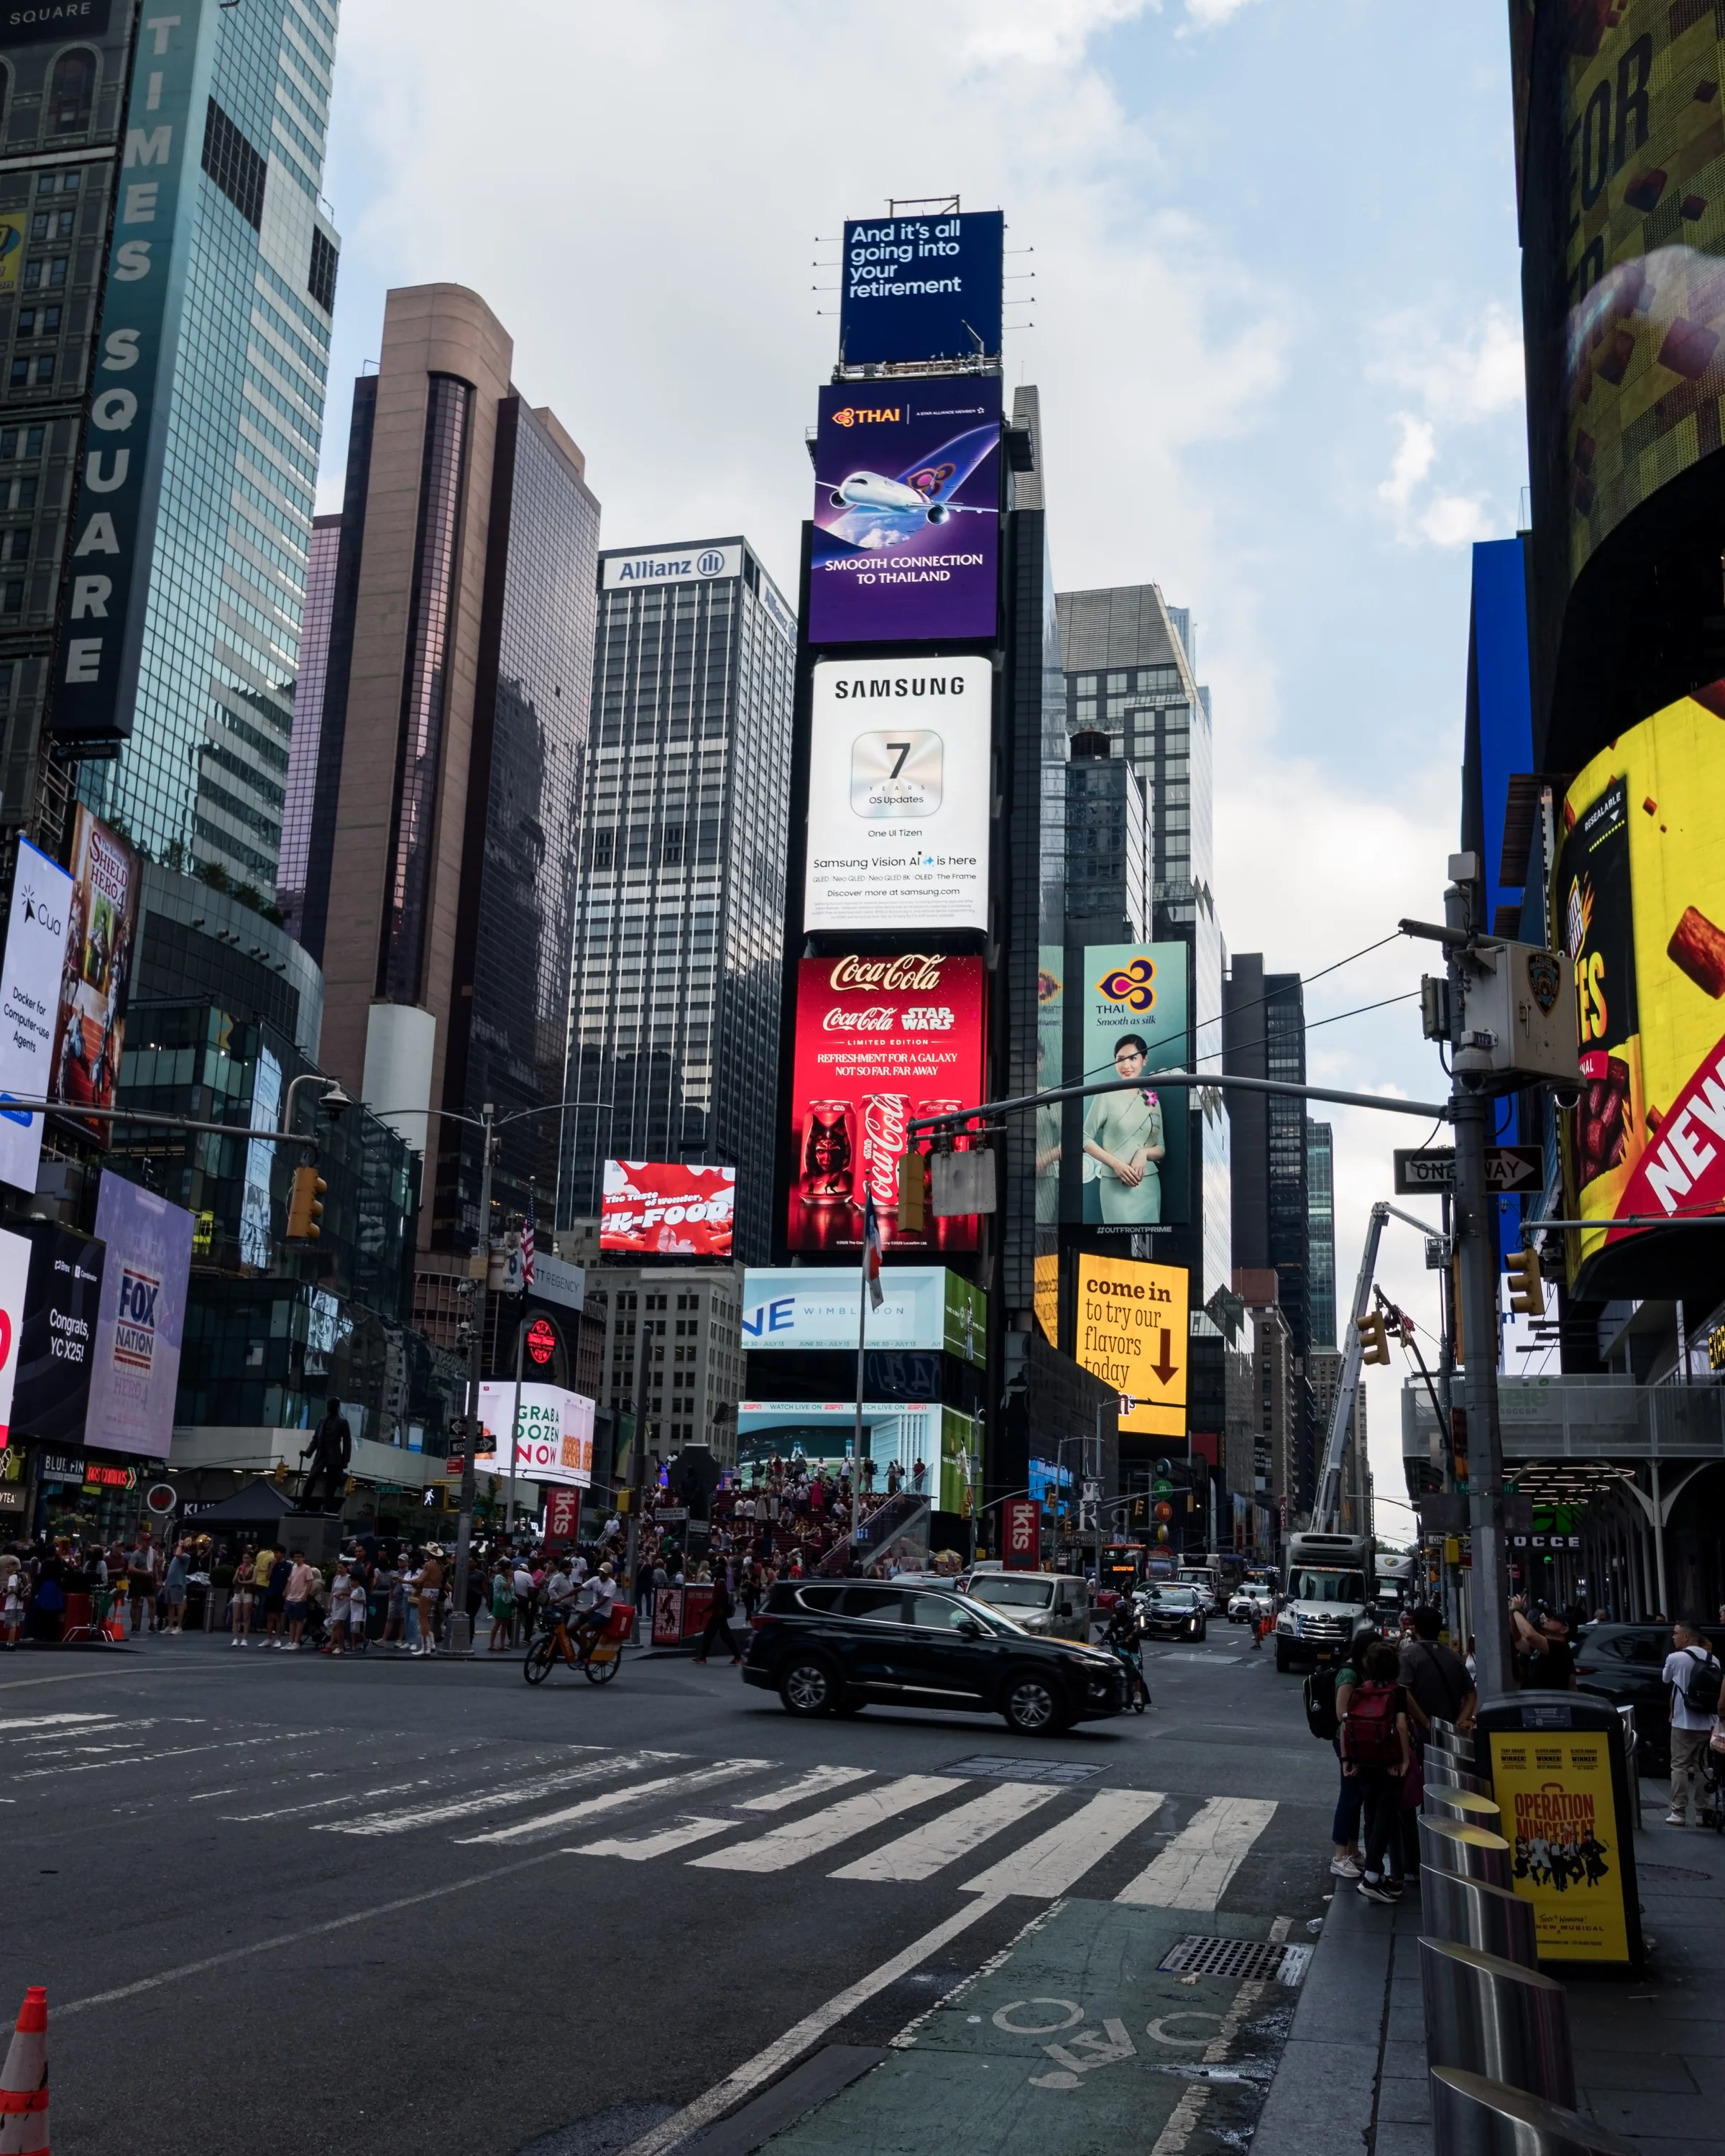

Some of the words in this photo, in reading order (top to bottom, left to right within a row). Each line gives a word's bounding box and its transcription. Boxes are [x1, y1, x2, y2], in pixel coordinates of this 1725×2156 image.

[9, 2, 91, 25] SQUARE
[114, 14, 182, 282] TIMES
[851, 224, 895, 243] And
[901, 223, 929, 240] it's
[935, 219, 960, 237] all
[851, 243, 913, 265] going
[919, 241, 960, 257] into
[850, 265, 898, 284] your
[850, 277, 962, 298] retirement
[855, 408, 900, 423] THAI
[64, 329, 142, 684] SQUARE
[619, 560, 691, 581] Allianz
[825, 558, 887, 571] SMOOTH
[891, 554, 983, 569] CONNECTION
[857, 573, 875, 584] TO
[878, 570, 950, 584] THAILAND
[834, 676, 965, 699] SAMSUNG
[886, 743, 911, 779] 7
[883, 796, 924, 806] Updates
[1584, 790, 1622, 832] RESEALABLE
[89, 831, 128, 888] SHIELD
[814, 858, 868, 870] Samsung
[871, 857, 906, 867] Vision
[937, 856, 946, 866] is
[949, 856, 977, 865] here
[91, 864, 118, 900] HERO
[117, 890, 125, 915] 4
[900, 889, 960, 897] samsung.com
[38, 903, 61, 935] Cua
[1530, 962, 1559, 975] DEPARTMENT
[1535, 955, 1552, 964] POLICE
[830, 954, 947, 991] Coca-Cola
[13, 986, 36, 1010] Docker
[37, 1000, 47, 1017] for
[1096, 1004, 1124, 1014] THAI
[4, 1004, 50, 1040] Computer-use
[822, 1007, 898, 1031] Coca-Cola
[901, 1007, 954, 1019] STAR
[901, 1019, 954, 1030] WARS
[1096, 1017, 1128, 1027] Smooth
[1142, 1015, 1156, 1025] silk
[13, 1030, 37, 1053] Agents
[1473, 1032, 1491, 1045] NYPD
[817, 1054, 887, 1063] REFRESHMENT
[888, 1053, 908, 1063] FOR
[909, 1053, 917, 1063] A
[918, 1052, 958, 1063] GALAXY
[835, 1067, 855, 1076] NOT
[857, 1067, 871, 1075] SO
[872, 1067, 891, 1077] FAR,
[893, 1067, 911, 1075] FAR
[912, 1066, 938, 1075] AWAY
[862, 1096, 903, 1206] Coca-Cola
[605, 1195, 625, 1204] The
[627, 1191, 658, 1202] Taste
[645, 1198, 657, 1206] of
[608, 1201, 730, 1232] K-FOOD
[60, 1261, 70, 1274] Brex
[80, 1270, 98, 1283] Combinator
[546, 1272, 580, 1293] REGENCY
[119, 1275, 160, 1329] FOX
[1086, 1279, 1145, 1300] come
[1148, 1281, 1172, 1303] in
[50, 1308, 89, 1341] Congrats,
[1086, 1298, 1102, 1321] to
[1105, 1300, 1132, 1331] try
[1135, 1308, 1162, 1329] our
[50, 1336, 63, 1356] YC
[65, 1341, 84, 1362] X25!
[116, 1326, 155, 1356] NATION
[1085, 1326, 1141, 1356] flavors
[1084, 1356, 1130, 1388] today
[517, 1424, 559, 1443] DOZEN
[515, 1444, 557, 1467] NOW
[554, 1491, 575, 1535] tkts
[1012, 1503, 1034, 1550] tkts
[1514, 1793, 1594, 1821] OPERATION
